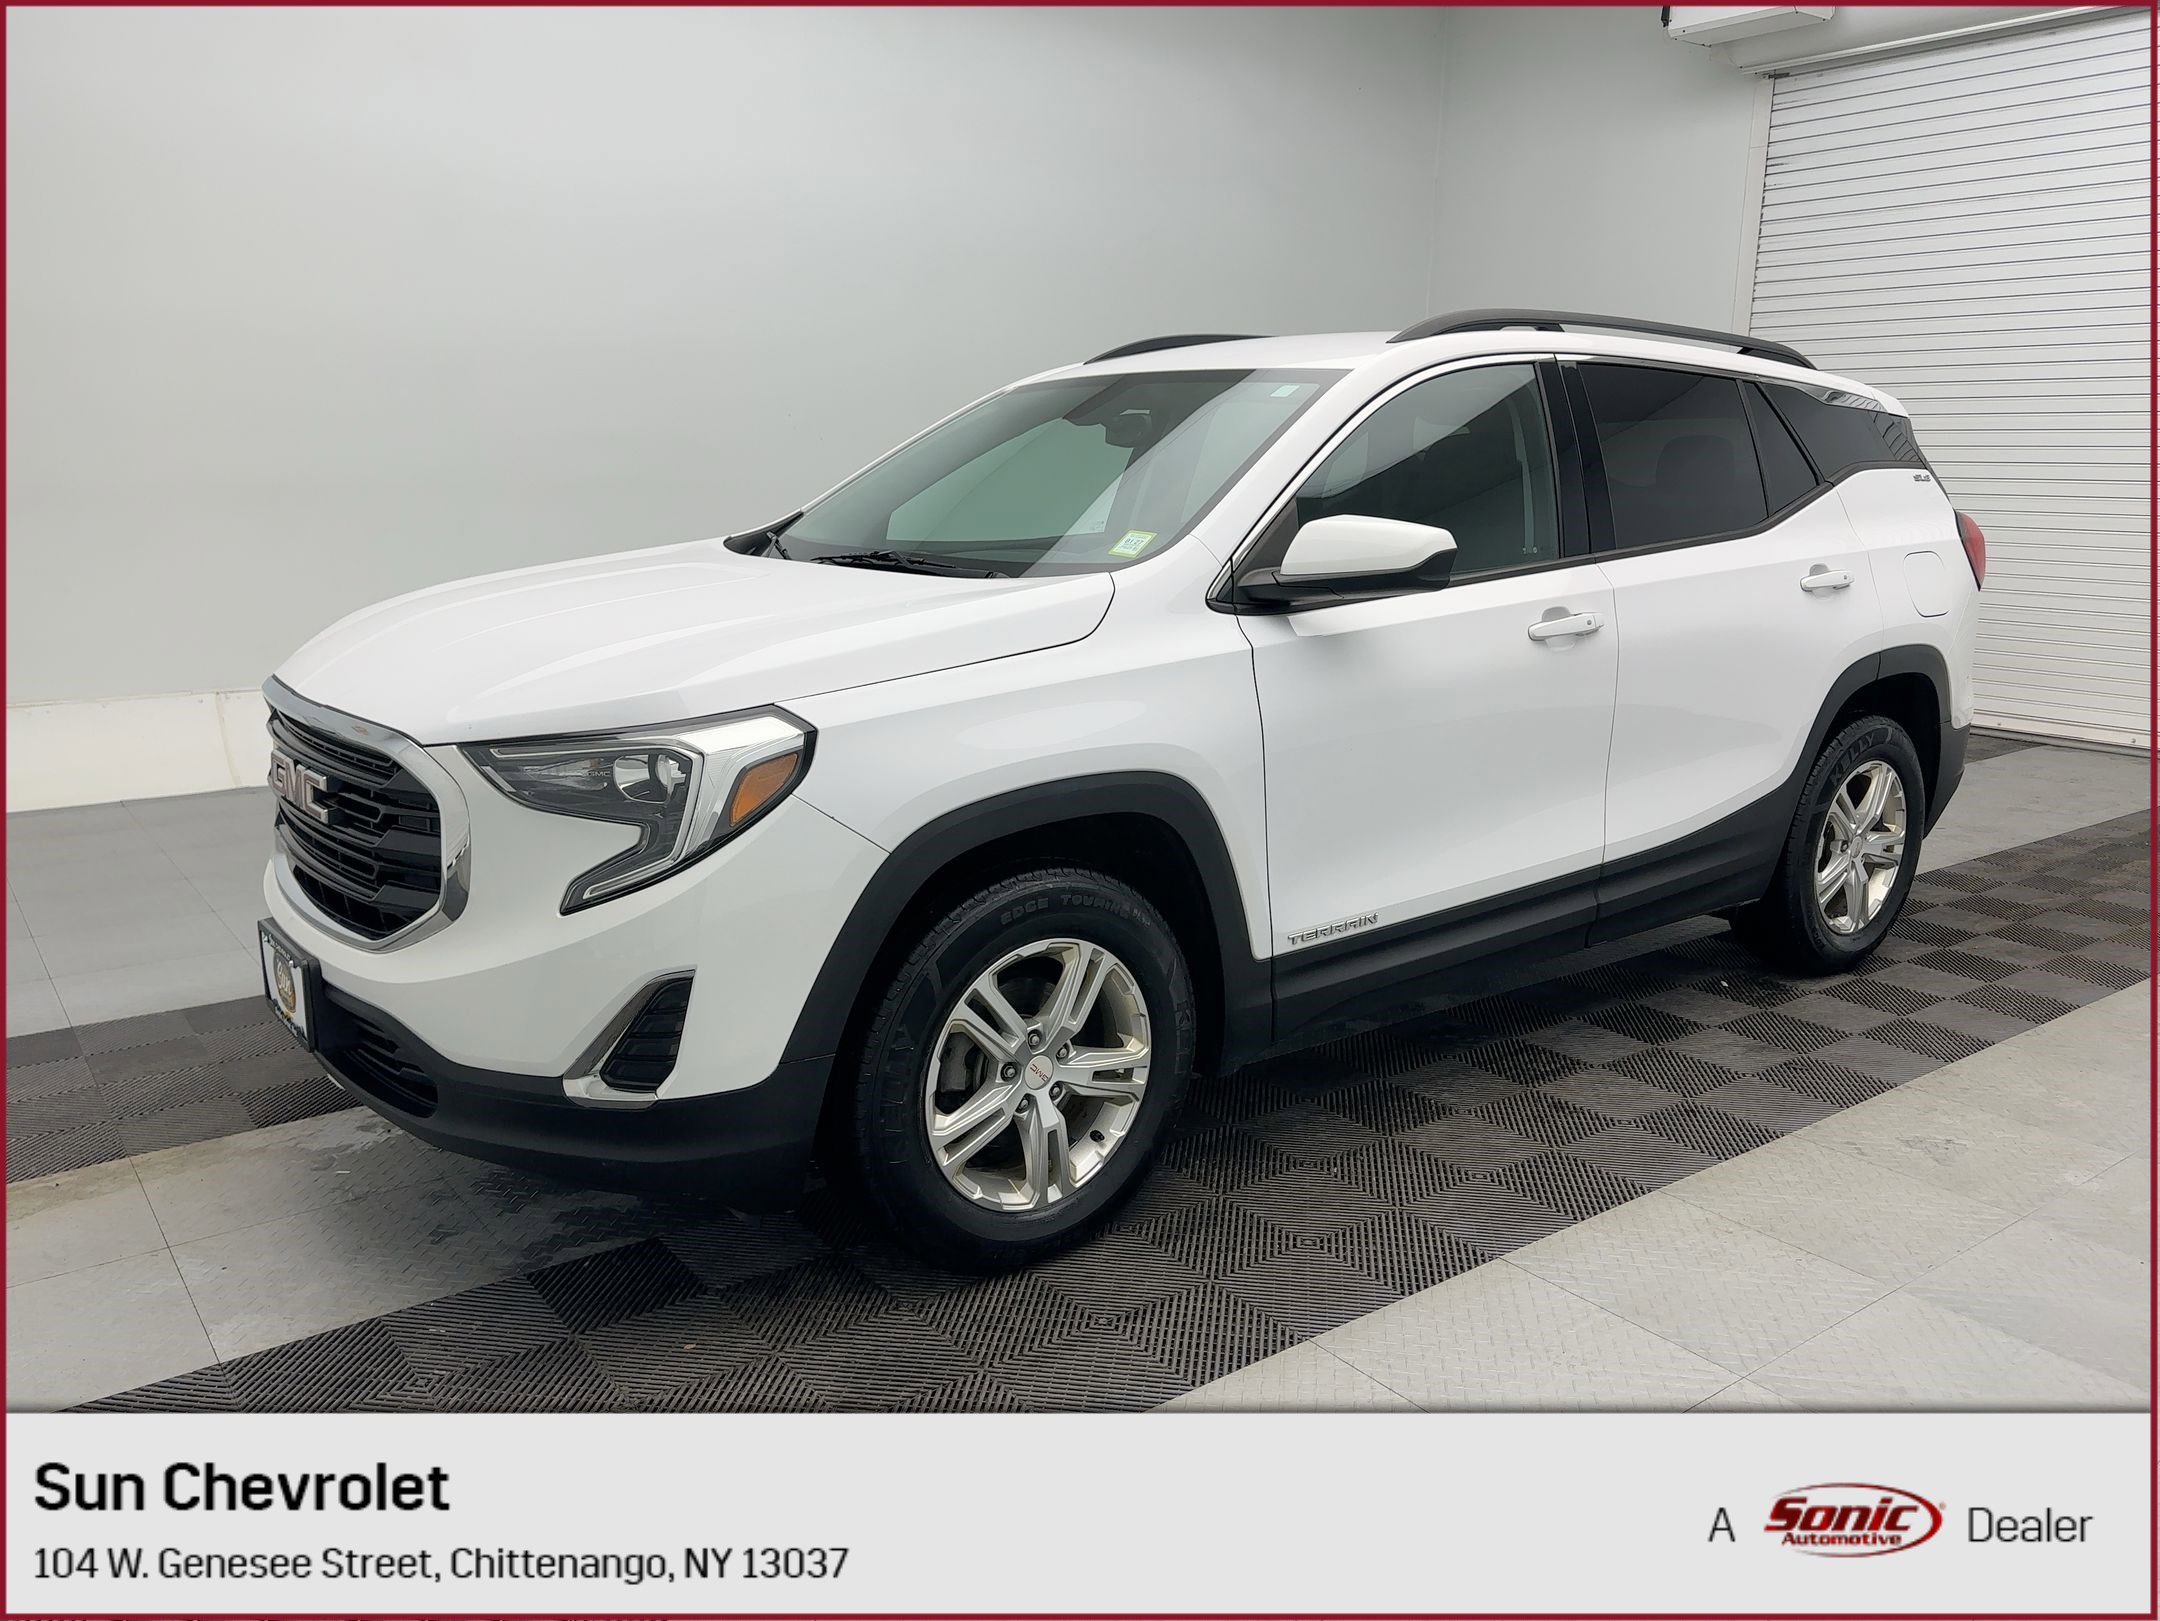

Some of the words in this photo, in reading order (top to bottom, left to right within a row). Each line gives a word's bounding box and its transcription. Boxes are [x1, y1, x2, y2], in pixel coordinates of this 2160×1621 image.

[271, 746, 329, 824] GMC
[1000, 896, 1049, 926] EDGE
[1060, 893, 1129, 920] TOURING
[1287, 911, 1379, 945] TERRAIN
[1029, 1063, 1049, 1083] GMC
